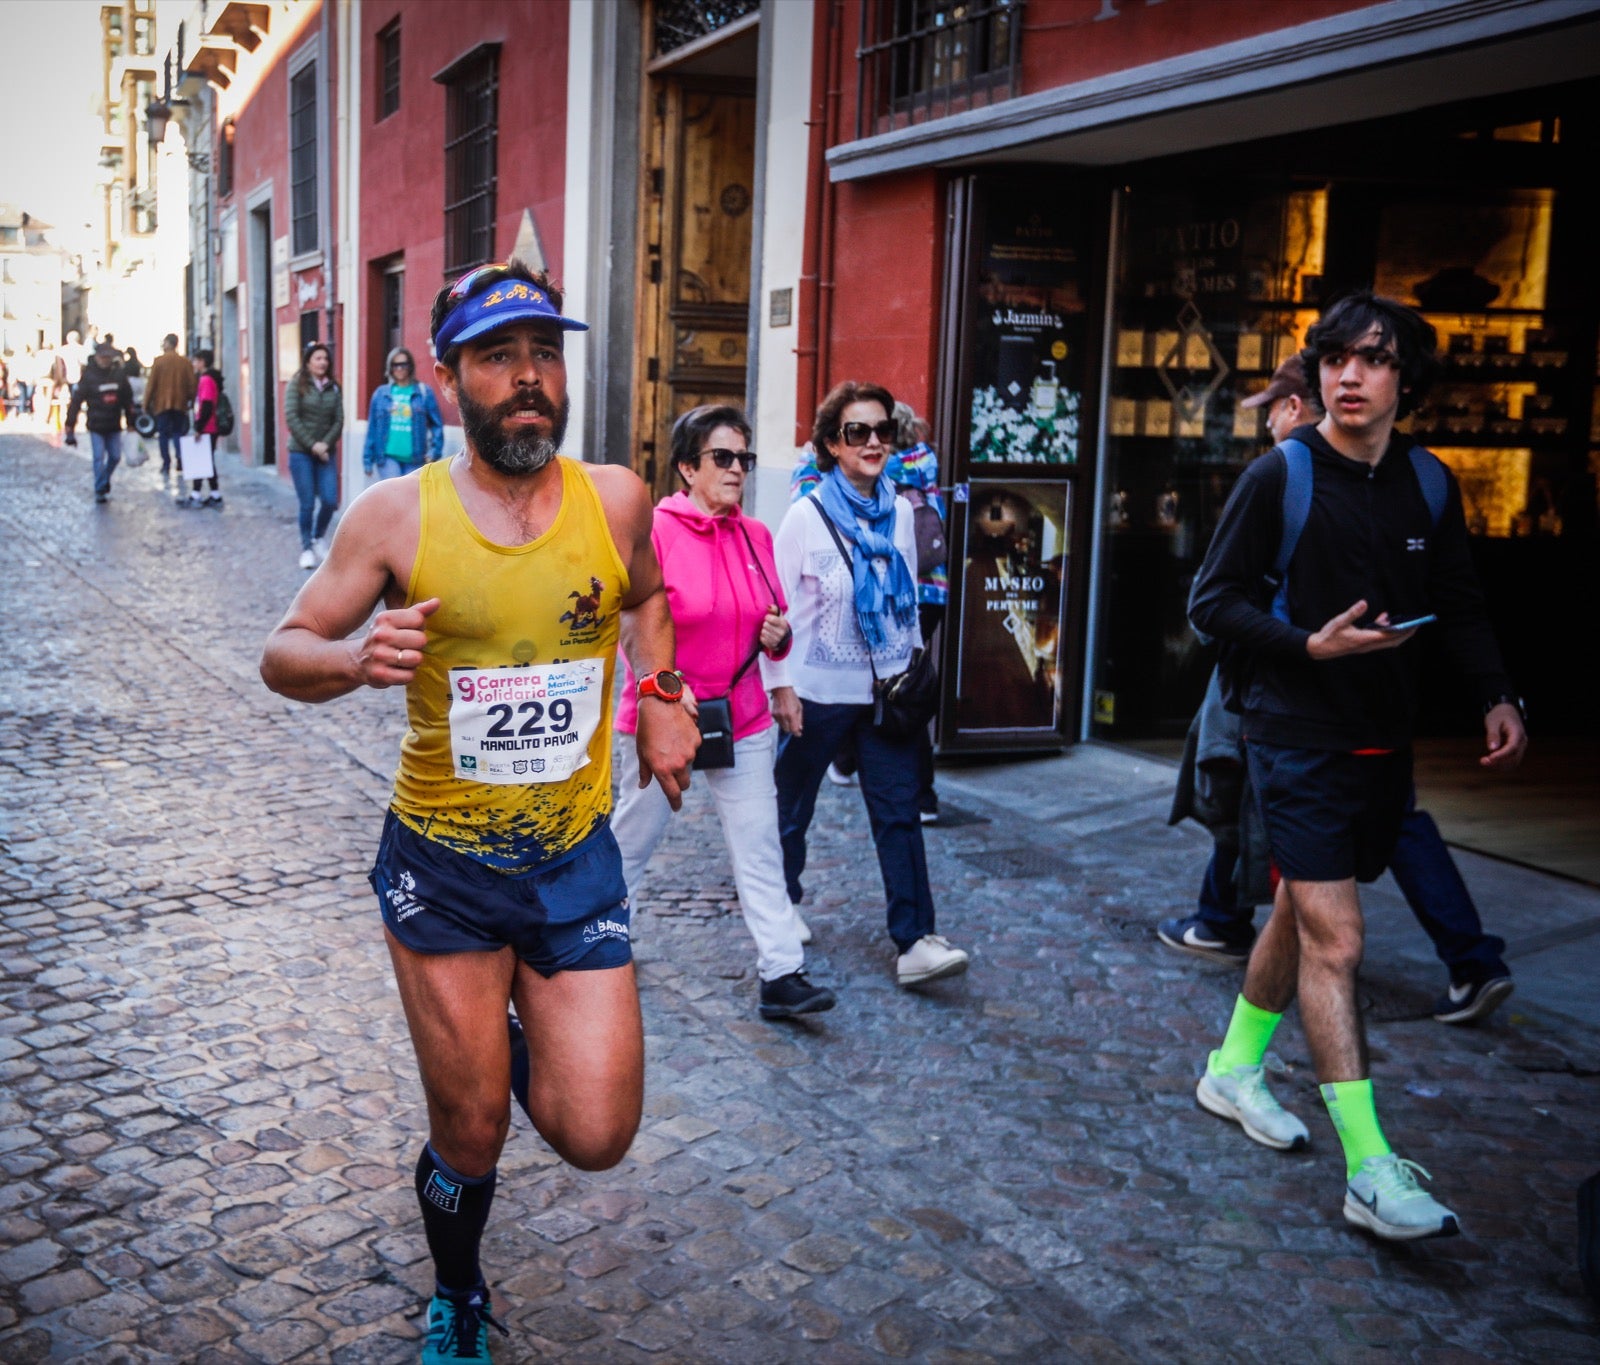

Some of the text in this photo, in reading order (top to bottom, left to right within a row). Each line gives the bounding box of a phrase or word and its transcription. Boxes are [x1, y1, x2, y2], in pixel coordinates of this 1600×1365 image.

[547, 673, 566, 681] Ave
[457, 675, 541, 702] 9 Carrera
[477, 687, 546, 703] Solidaria
[547, 686, 588, 697] Granada
[486, 698, 573, 738] 229
[480, 738, 540, 751] MANOLITO
